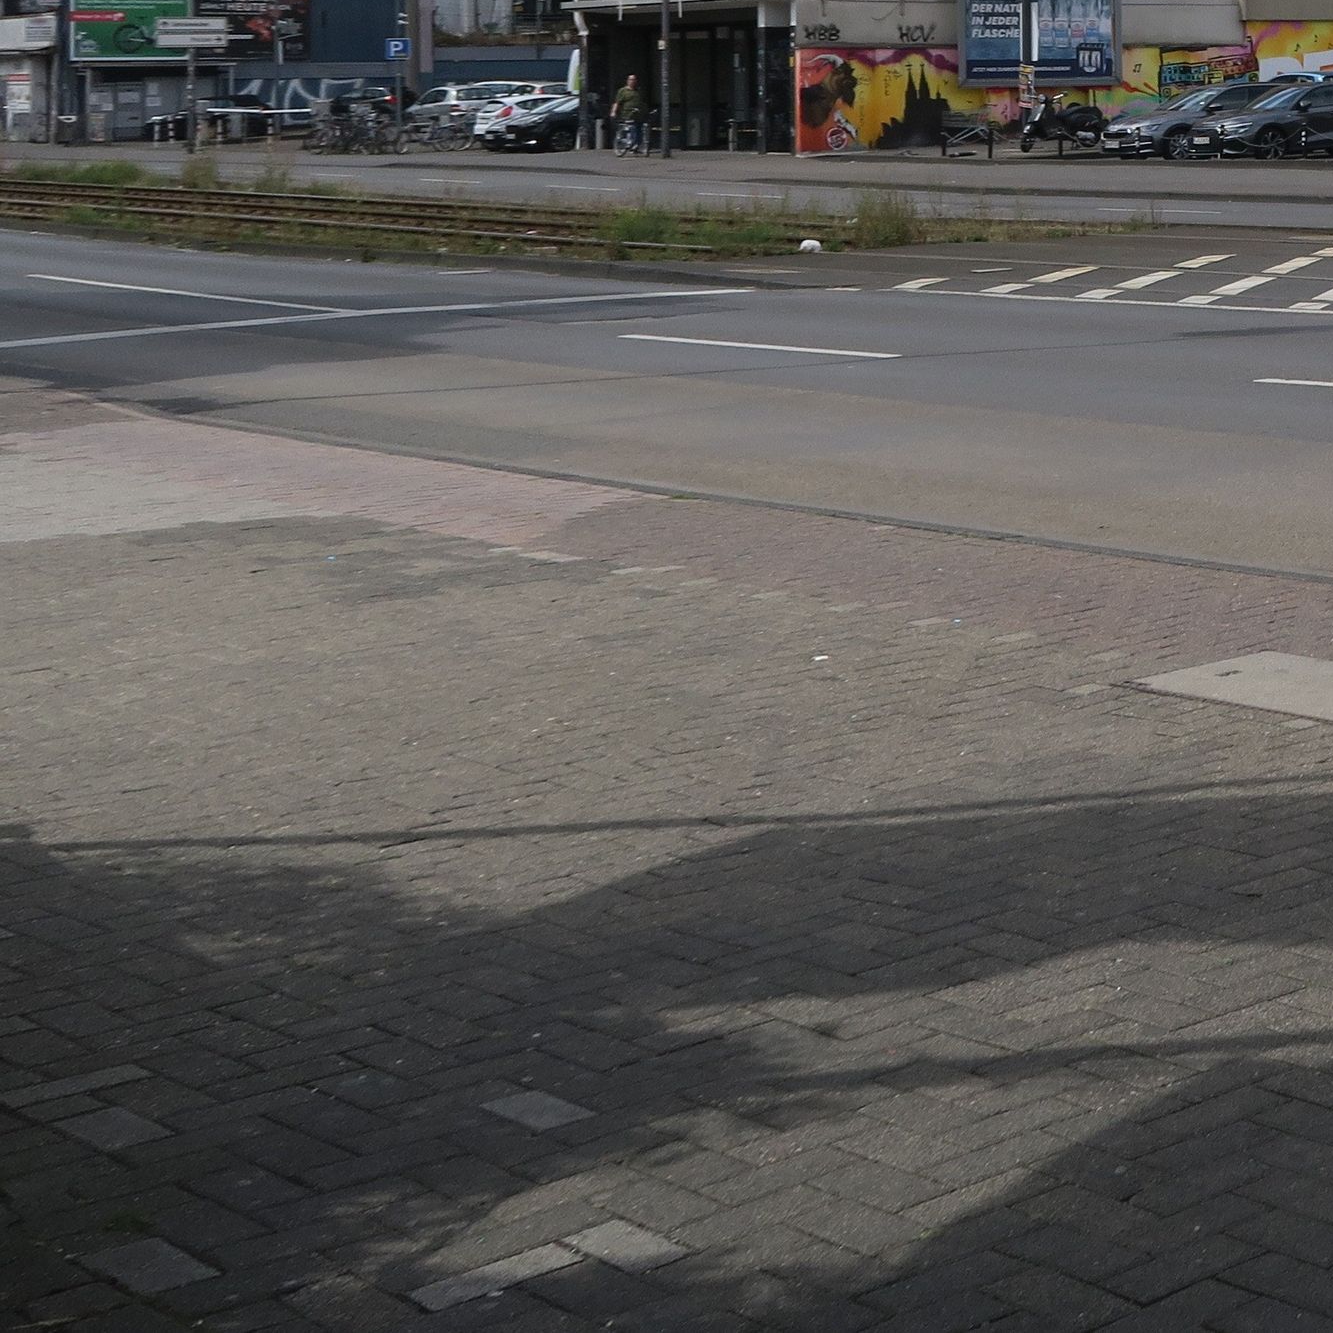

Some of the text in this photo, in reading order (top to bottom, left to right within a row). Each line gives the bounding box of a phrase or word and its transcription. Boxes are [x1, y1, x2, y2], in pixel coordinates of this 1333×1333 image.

[226, 2, 268, 12] HEUTE
[971, 4, 993, 14] DER
[971, 16, 1018, 26] IN JEDER
[971, 28, 1021, 39] FLASCHE
[391, 39, 405, 56] P
